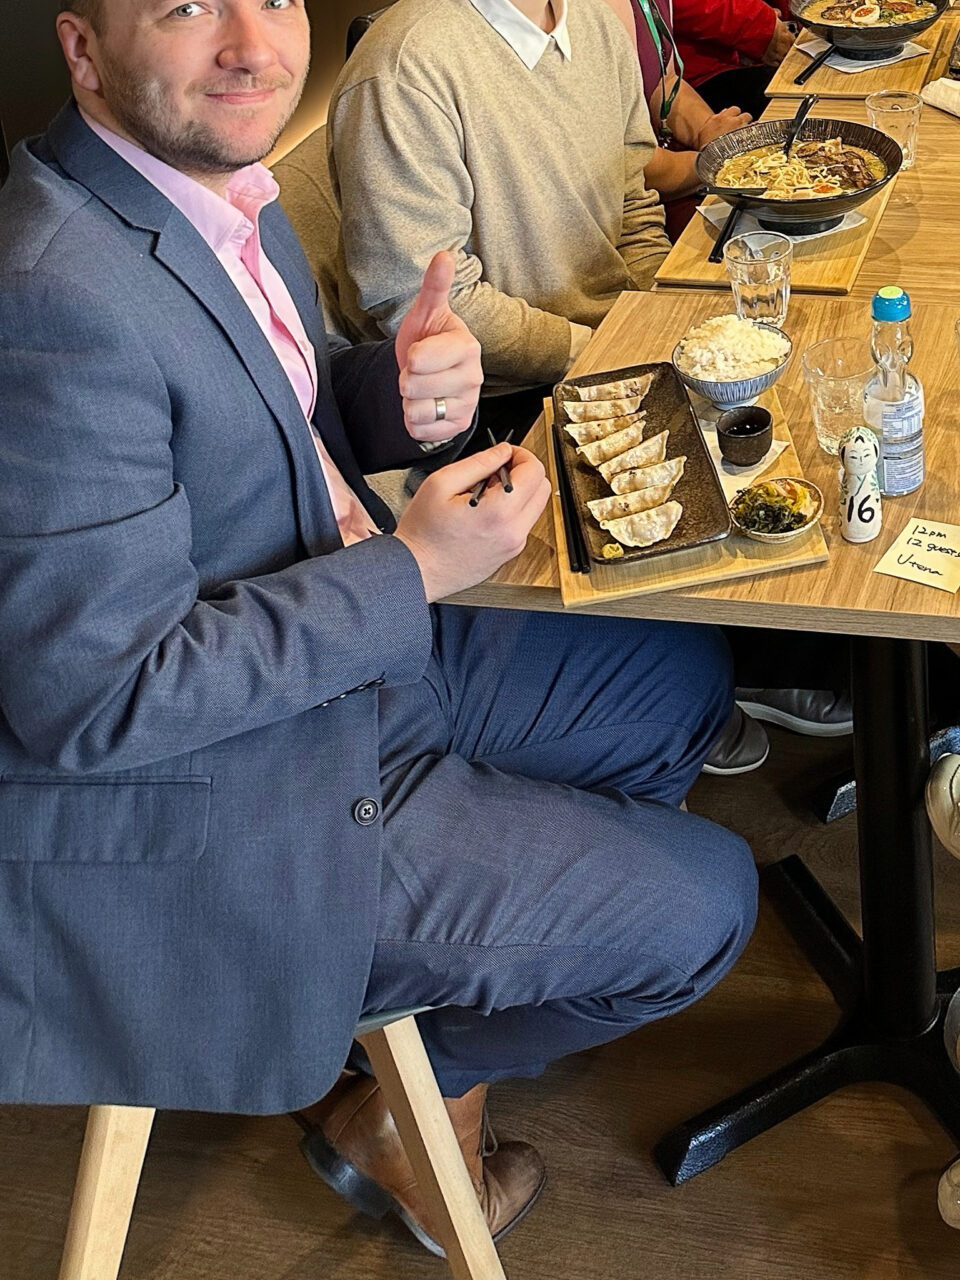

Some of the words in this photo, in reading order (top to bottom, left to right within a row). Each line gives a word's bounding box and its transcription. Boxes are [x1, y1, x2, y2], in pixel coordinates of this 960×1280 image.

[847, 494, 875, 523] 16
[912, 525, 947, 538] 12pm
[906, 537, 923, 548] 12
